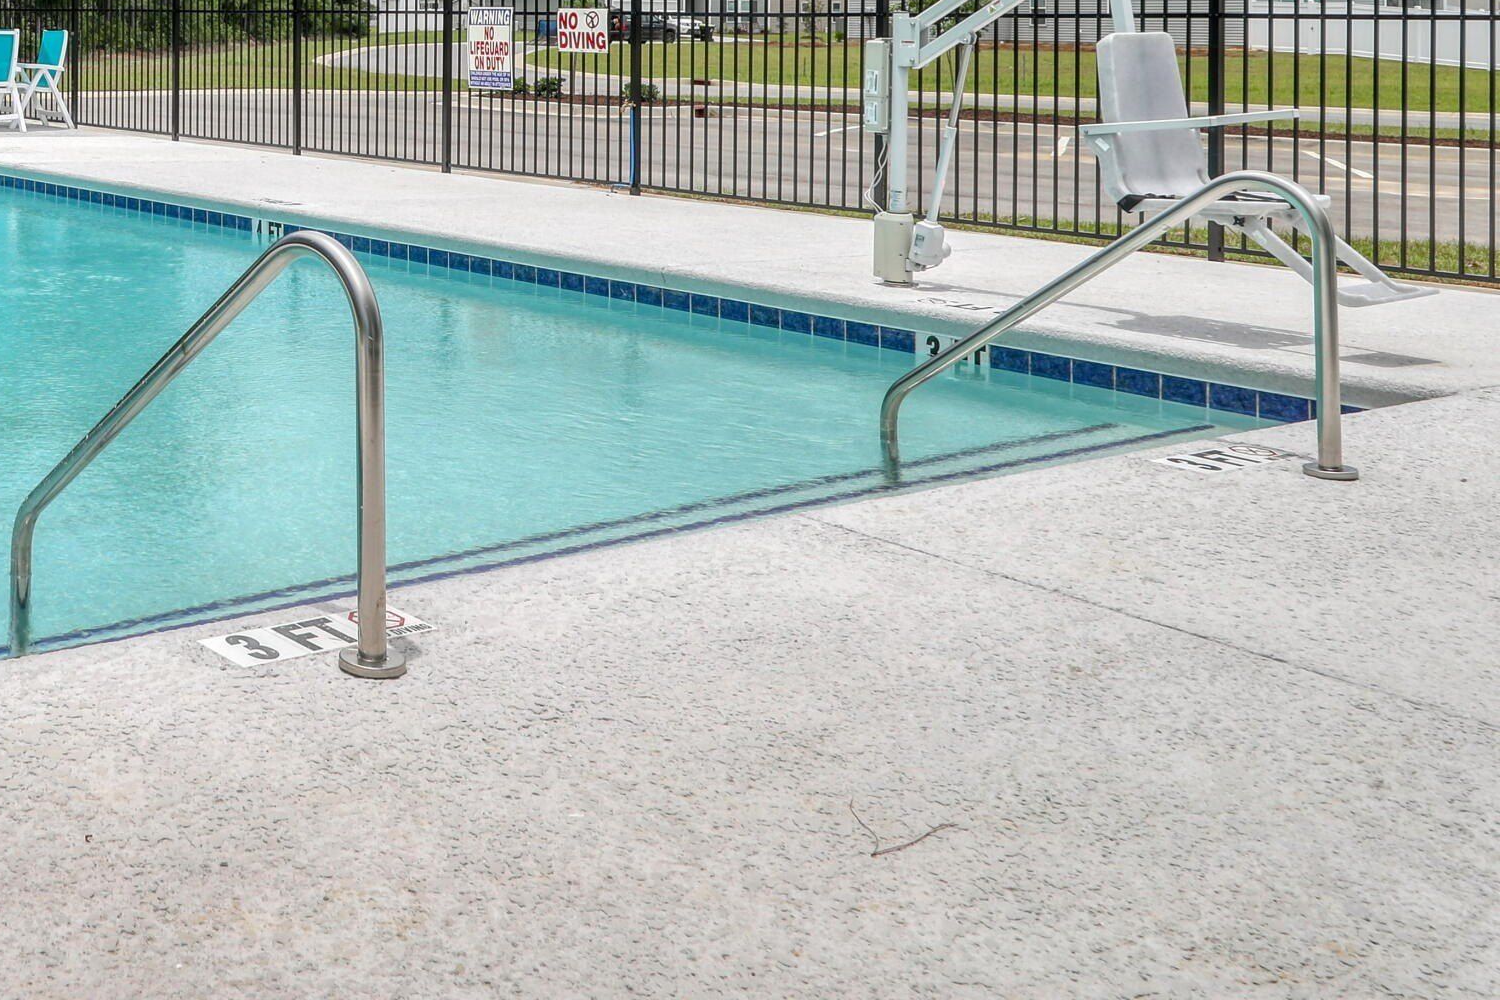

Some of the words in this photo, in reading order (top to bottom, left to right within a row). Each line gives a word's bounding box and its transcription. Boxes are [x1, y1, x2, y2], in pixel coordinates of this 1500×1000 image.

[470, 9, 510, 25] WARNING
[559, 12, 578, 30] NO
[484, 27, 495, 41] NO
[559, 31, 606, 49] DIVING
[469, 41, 509, 56] LIFEGUARD
[475, 56, 484, 70] ON
[487, 57, 505, 71] DUTY
[1167, 457, 1222, 471] 3
[1190, 450, 1261, 467] FT
[225, 634, 280, 660] 3
[271, 616, 358, 651] FT
